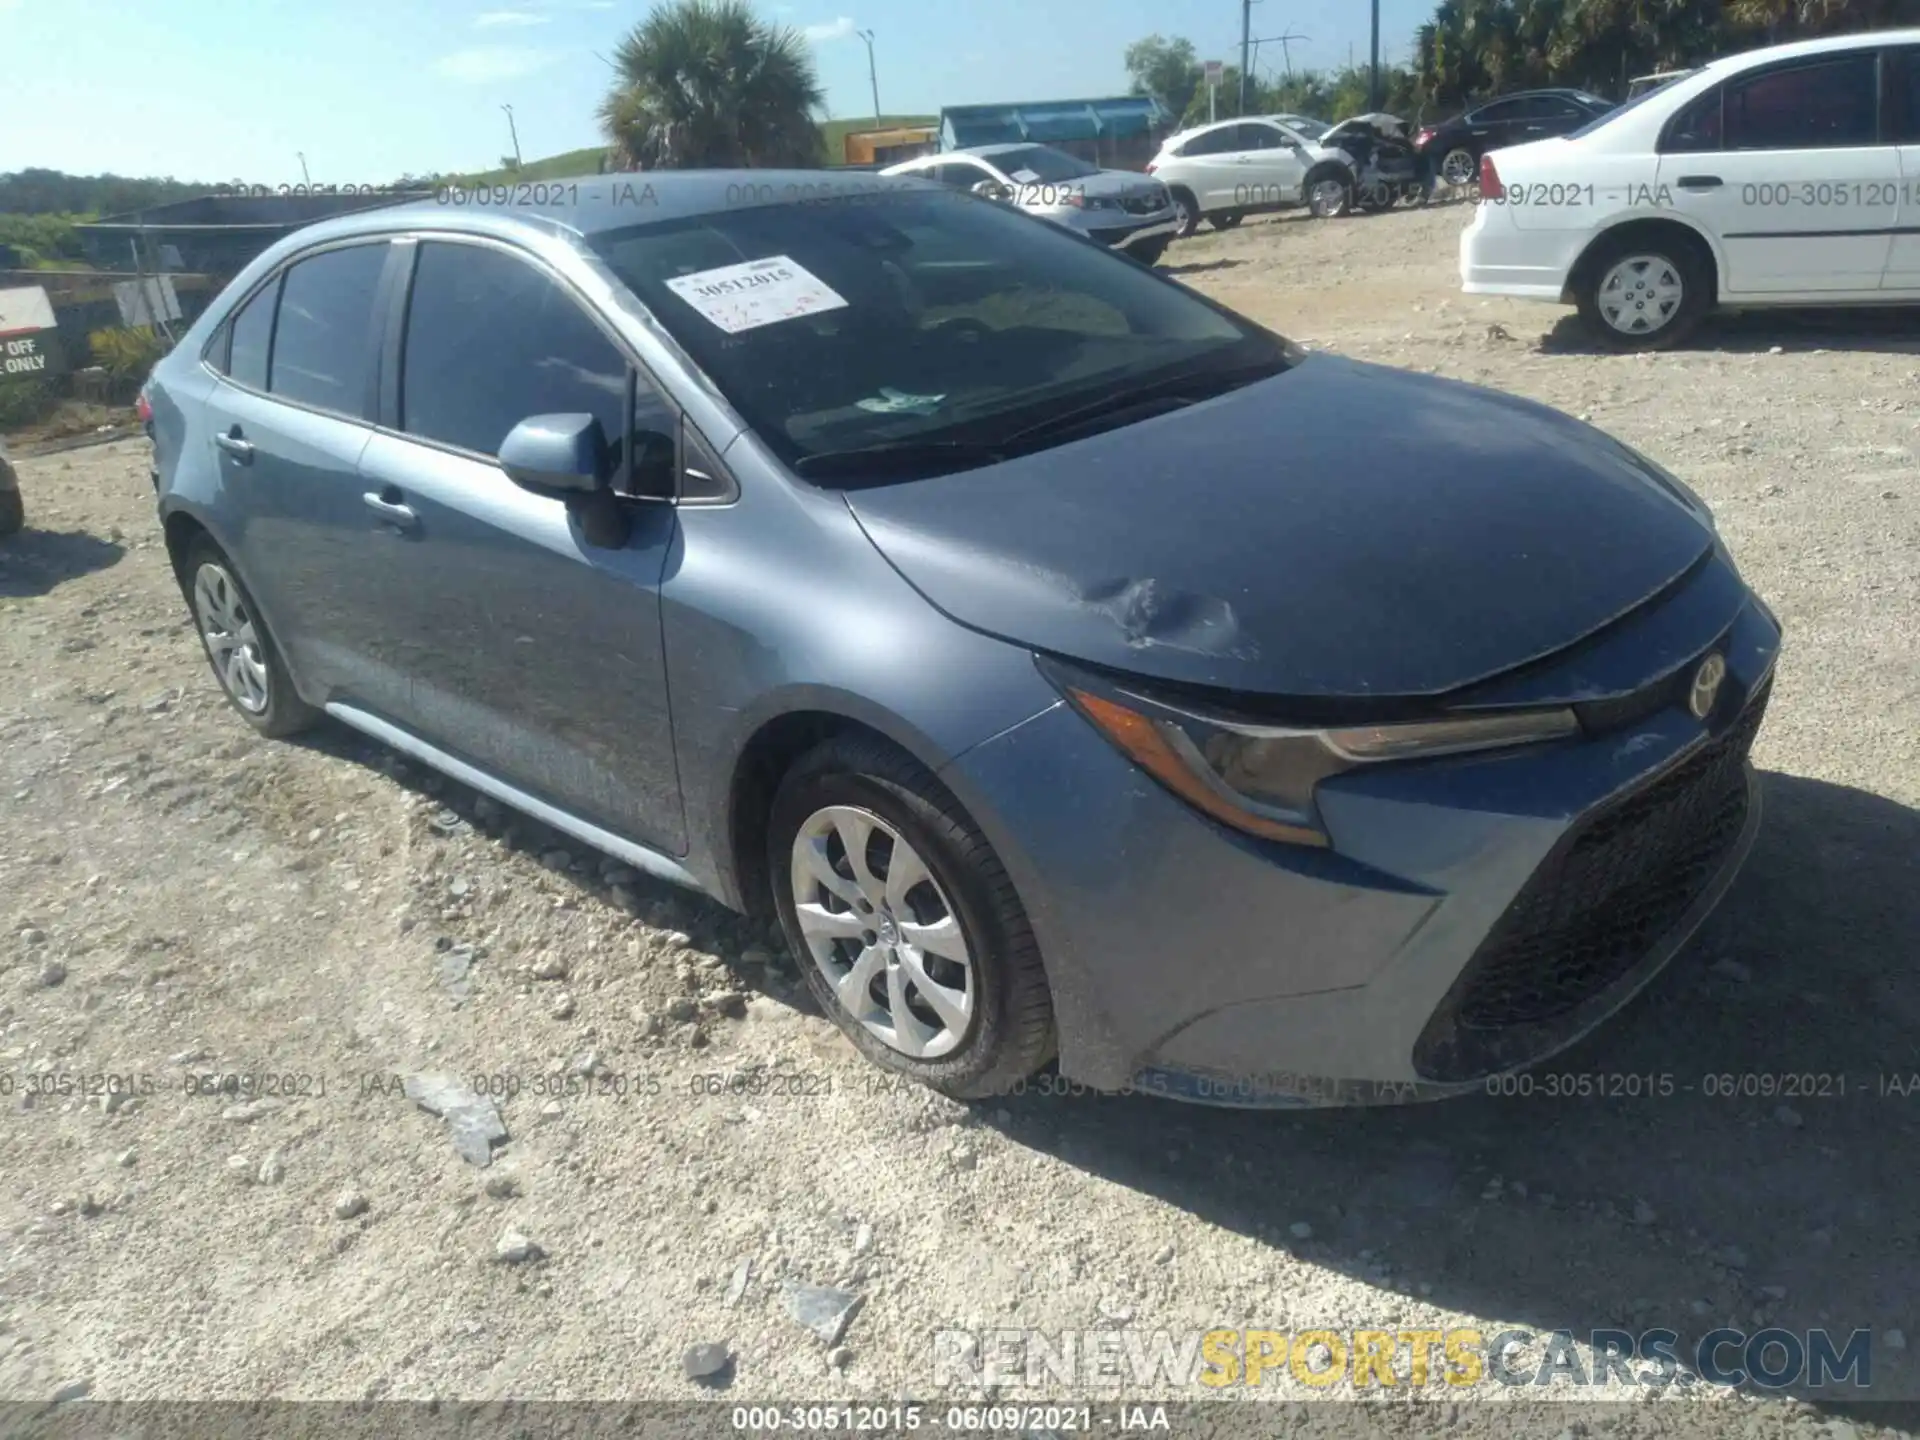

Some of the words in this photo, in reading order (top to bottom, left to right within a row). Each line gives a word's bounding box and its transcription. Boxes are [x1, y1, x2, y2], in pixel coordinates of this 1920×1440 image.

[692, 268, 794, 298] 30512015
[7, 339, 37, 355] OFF
[6, 354, 45, 373] ONLY
